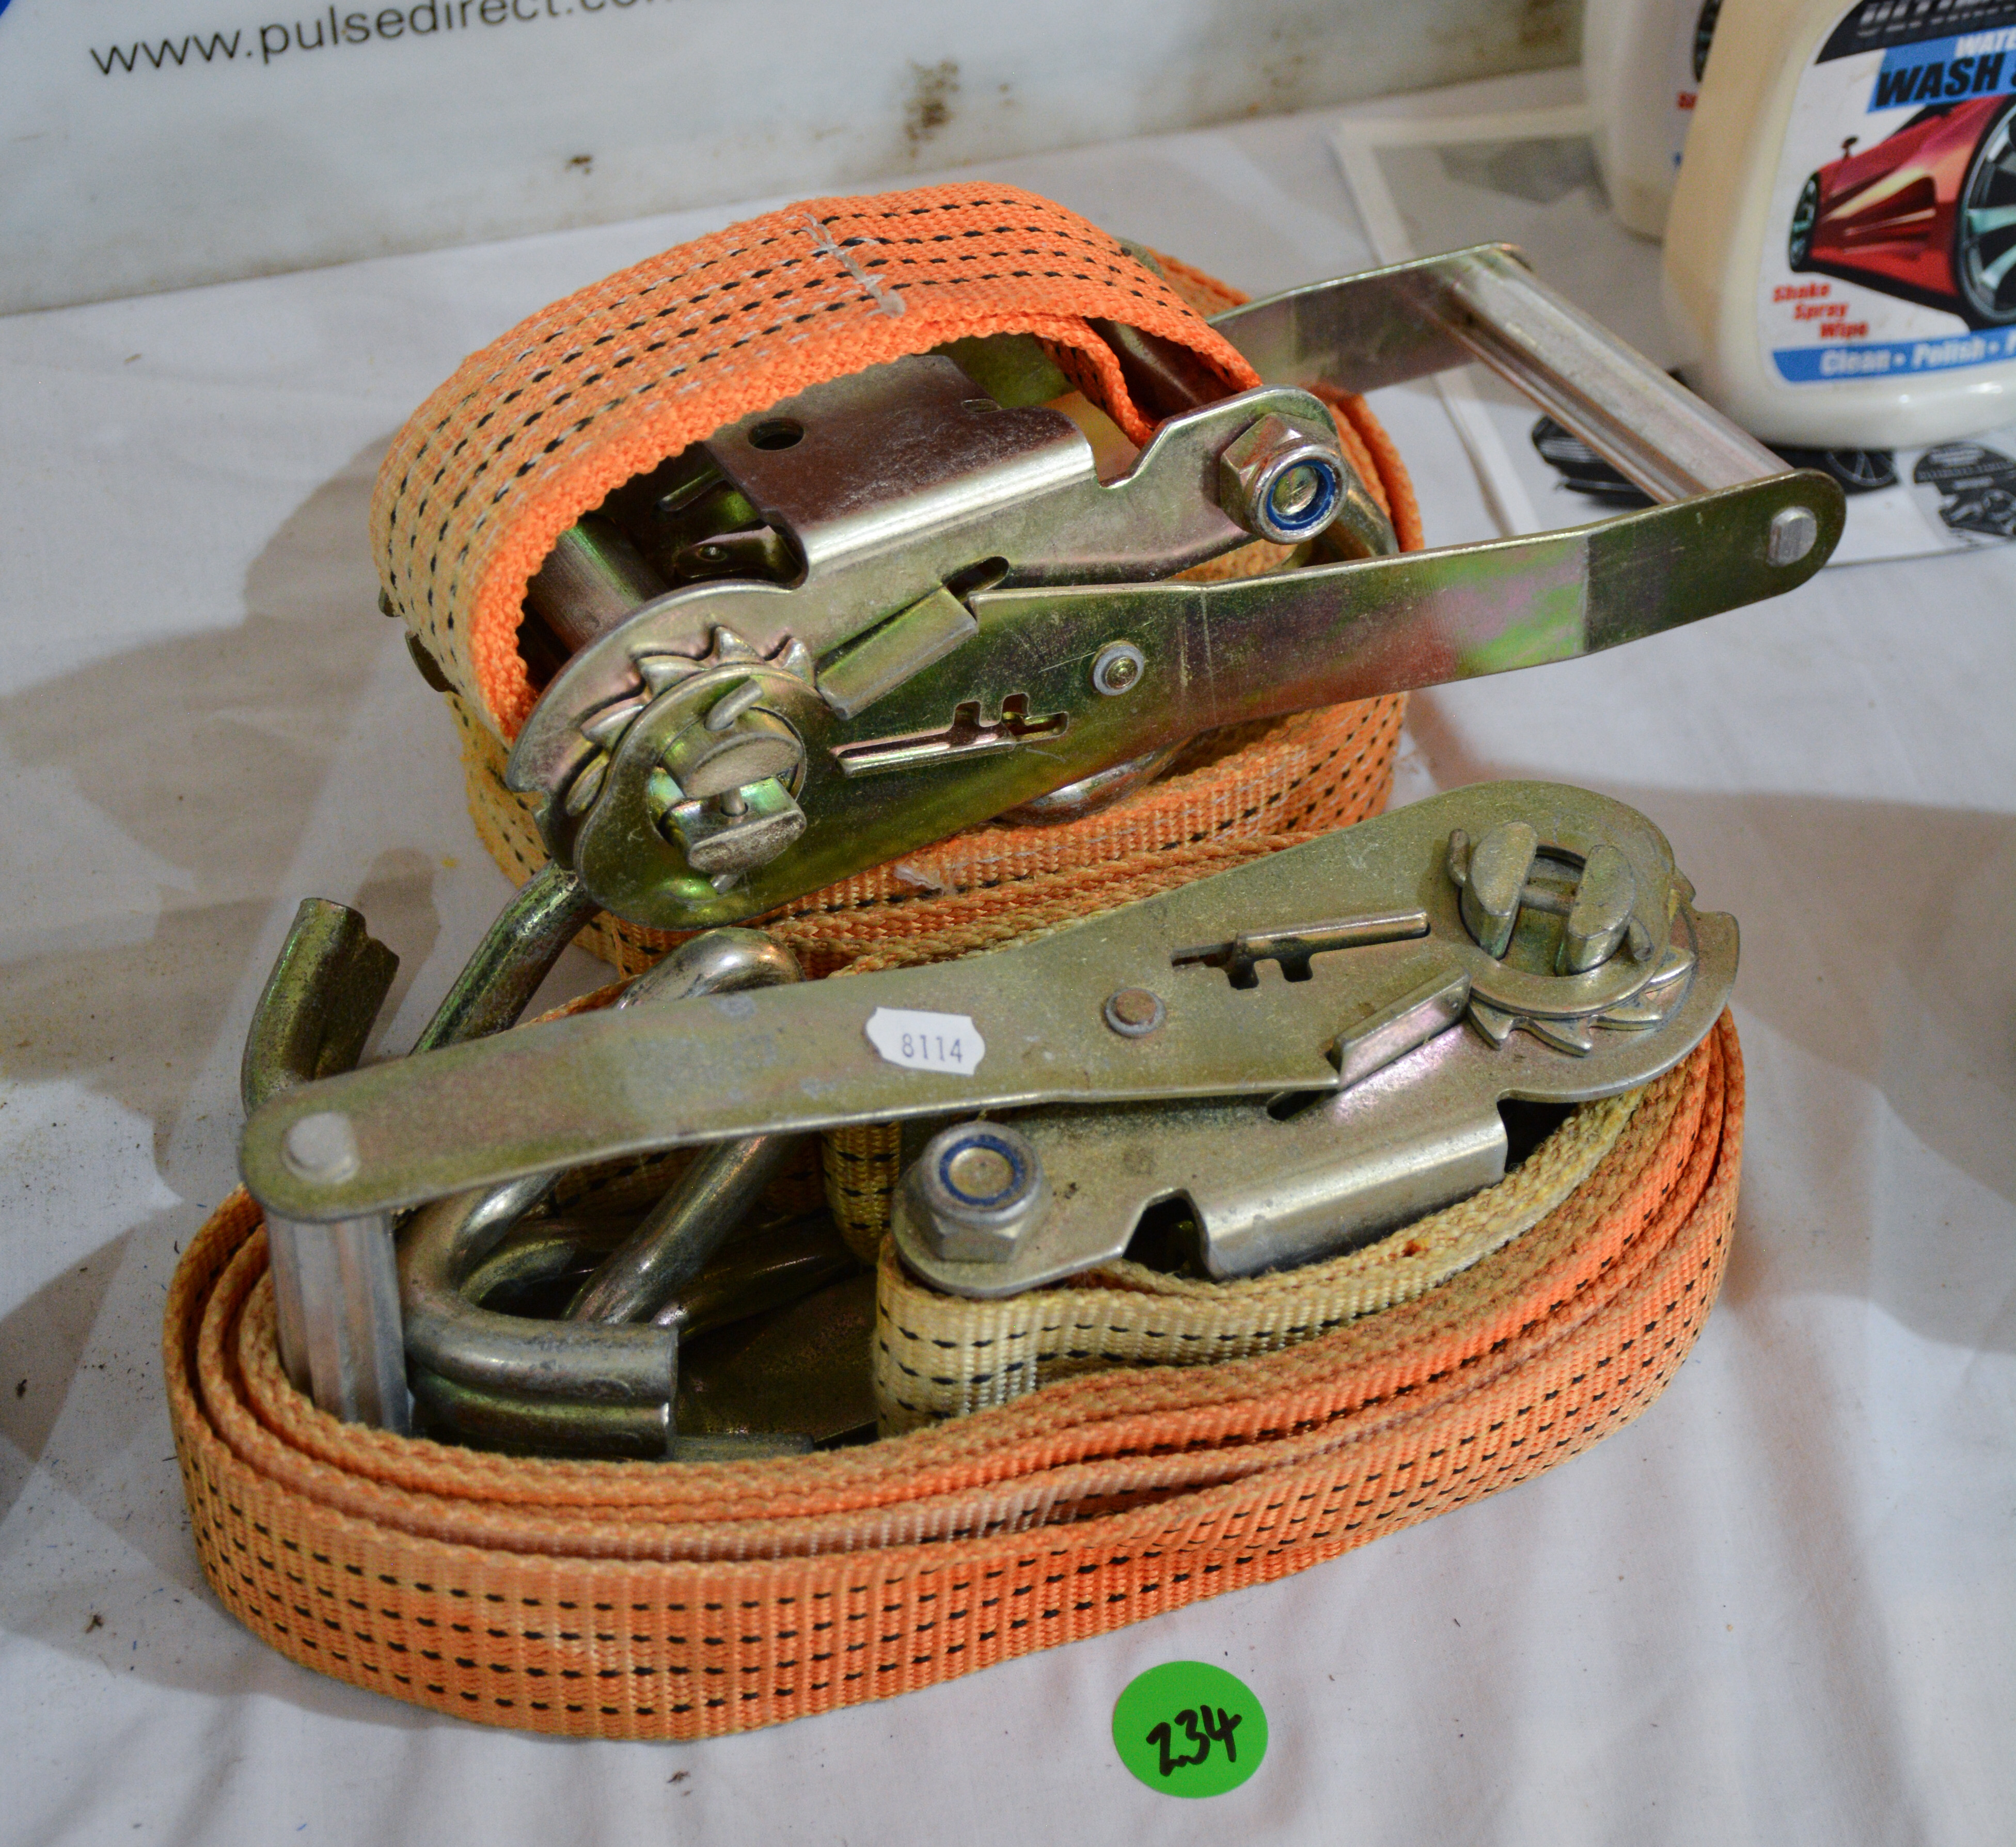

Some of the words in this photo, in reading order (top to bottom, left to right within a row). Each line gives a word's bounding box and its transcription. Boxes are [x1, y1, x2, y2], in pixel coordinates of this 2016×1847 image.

[90, 0, 653, 75] www.pulsedirec.
[1876, 52, 2006, 106] WASH
[1773, 282, 1831, 303] Shake
[1794, 303, 1849, 322] Spray
[1820, 321, 1869, 339] Wipe
[1821, 349, 1892, 376] Clean
[1912, 336, 1986, 369] Polish
[901, 1033, 963, 1063] 8114
[1145, 1704, 1243, 1777] 234
